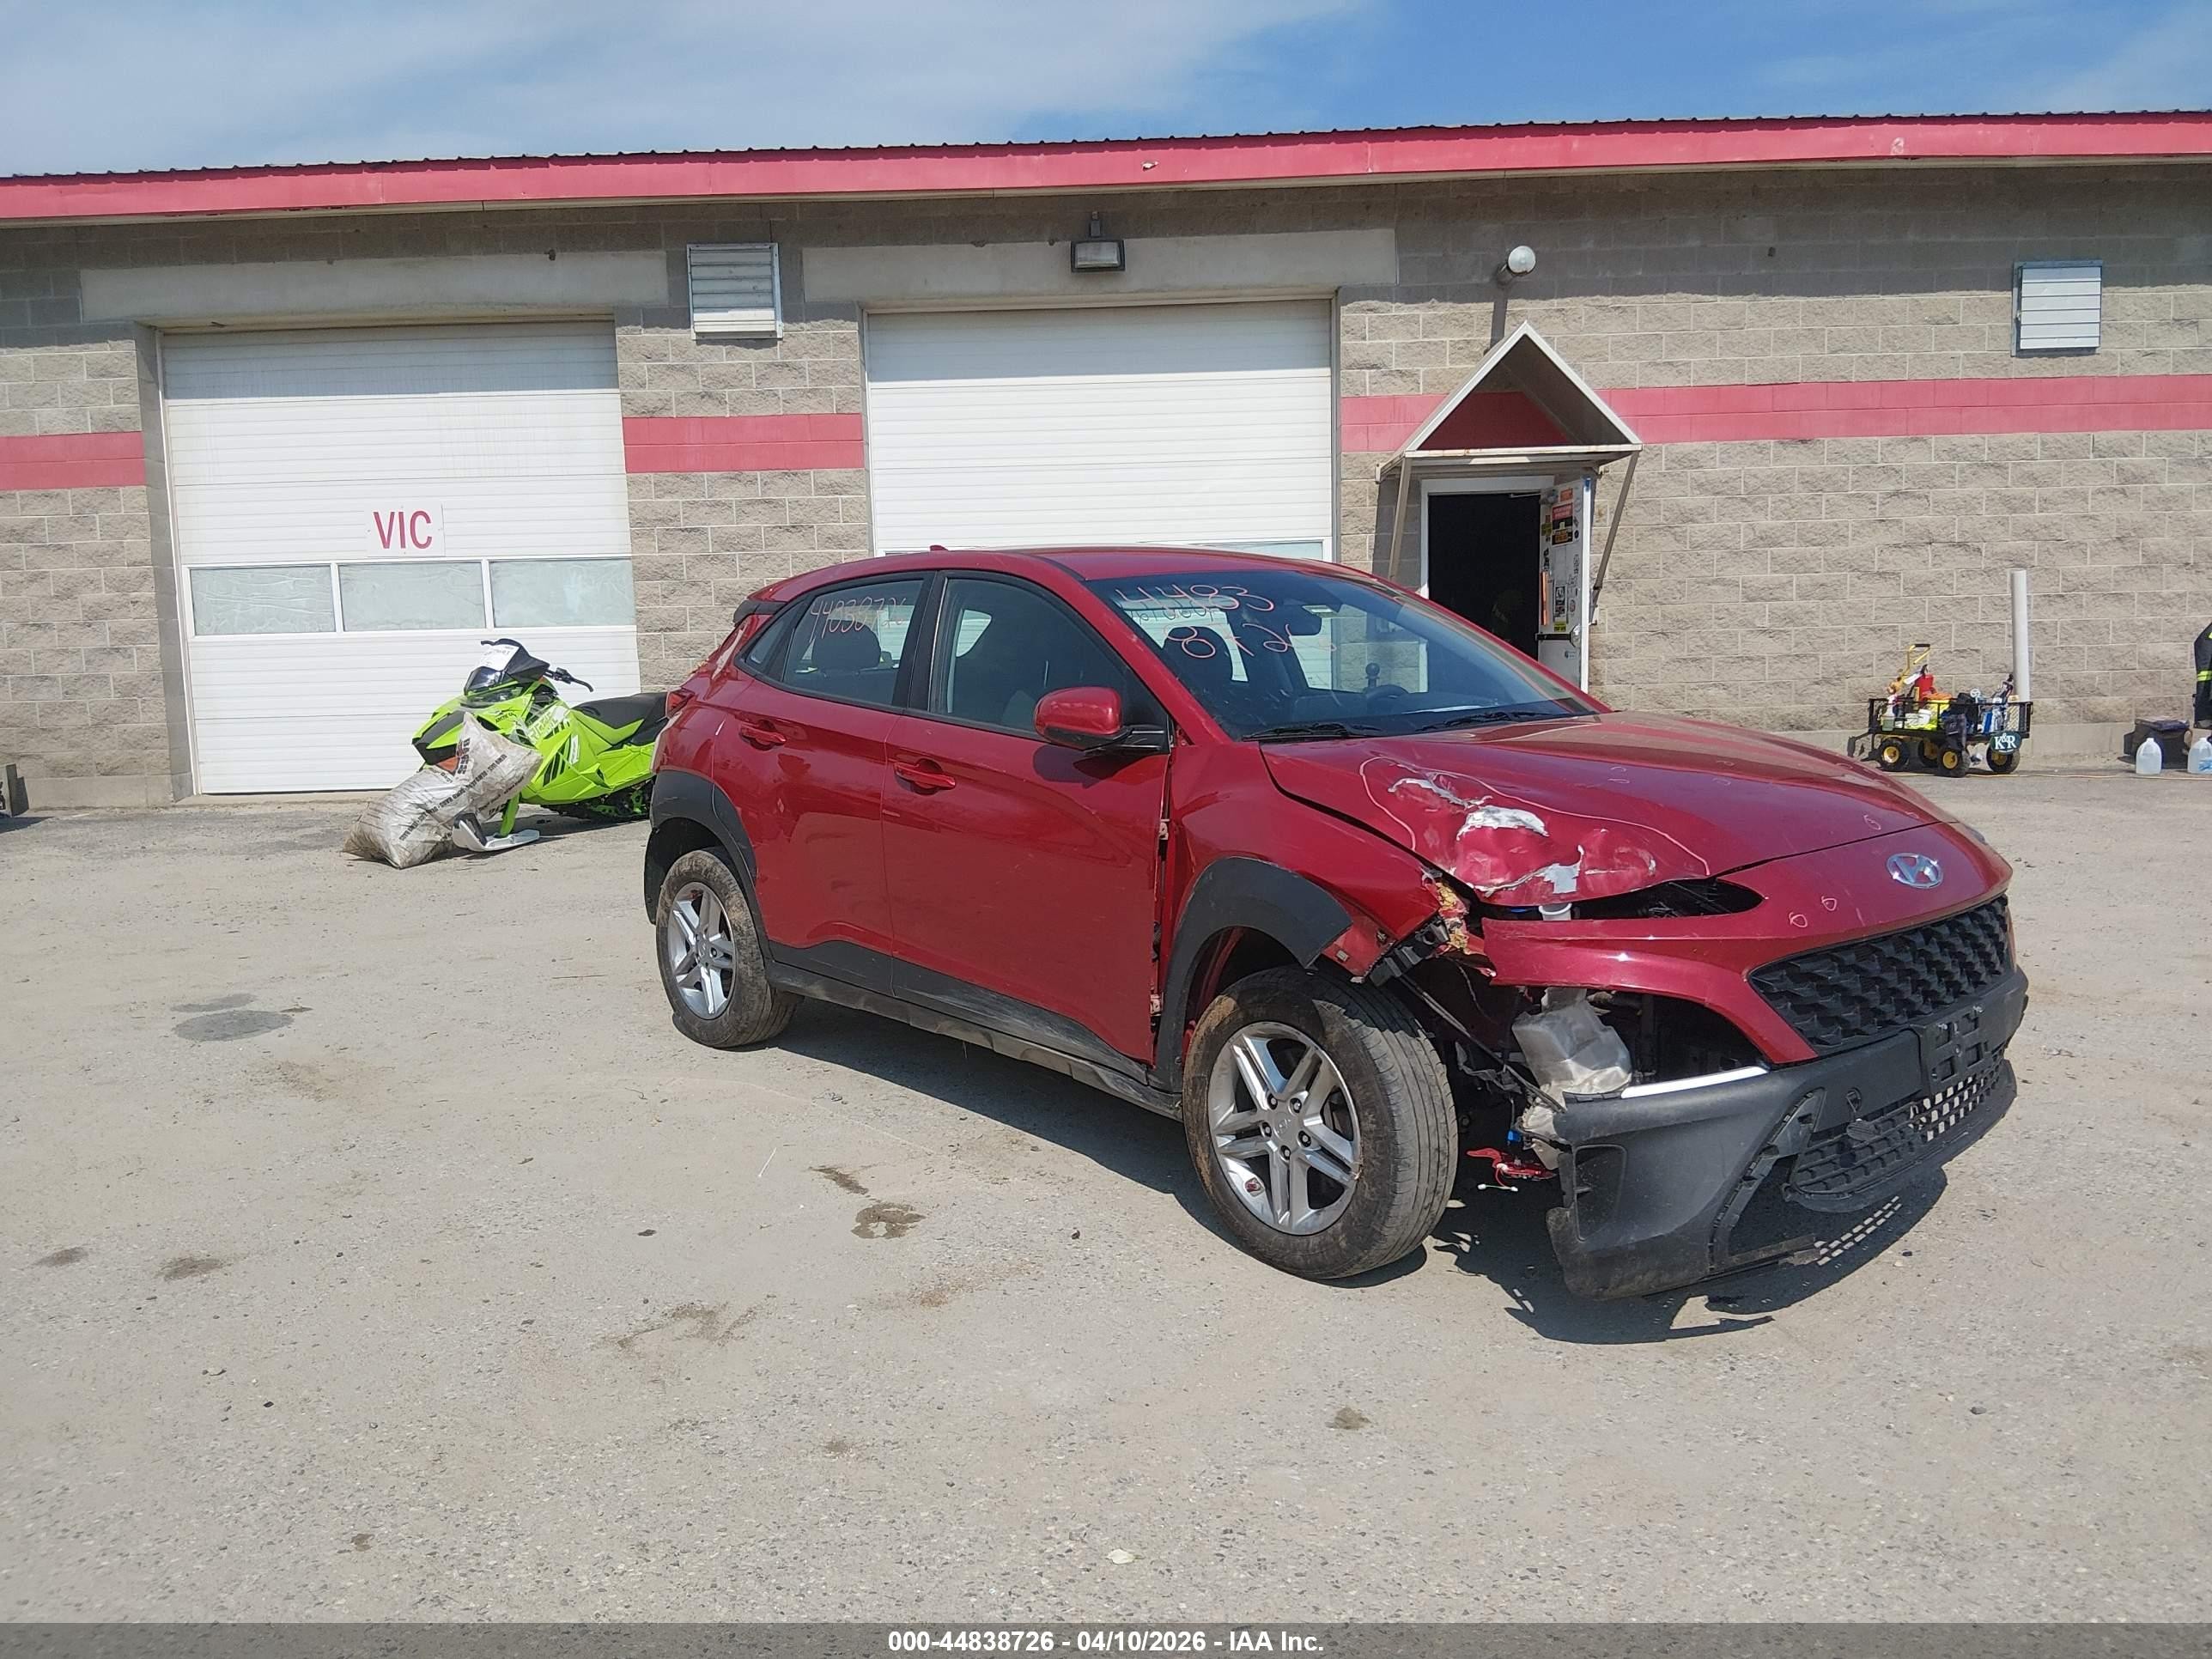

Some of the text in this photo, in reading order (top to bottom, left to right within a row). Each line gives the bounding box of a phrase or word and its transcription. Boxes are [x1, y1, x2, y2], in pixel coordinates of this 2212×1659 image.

[372, 509, 434, 550] VIC
[1115, 584, 1275, 617] 4483
[808, 596, 907, 643] 44838726
[1993, 732, 2017, 750] K&R
